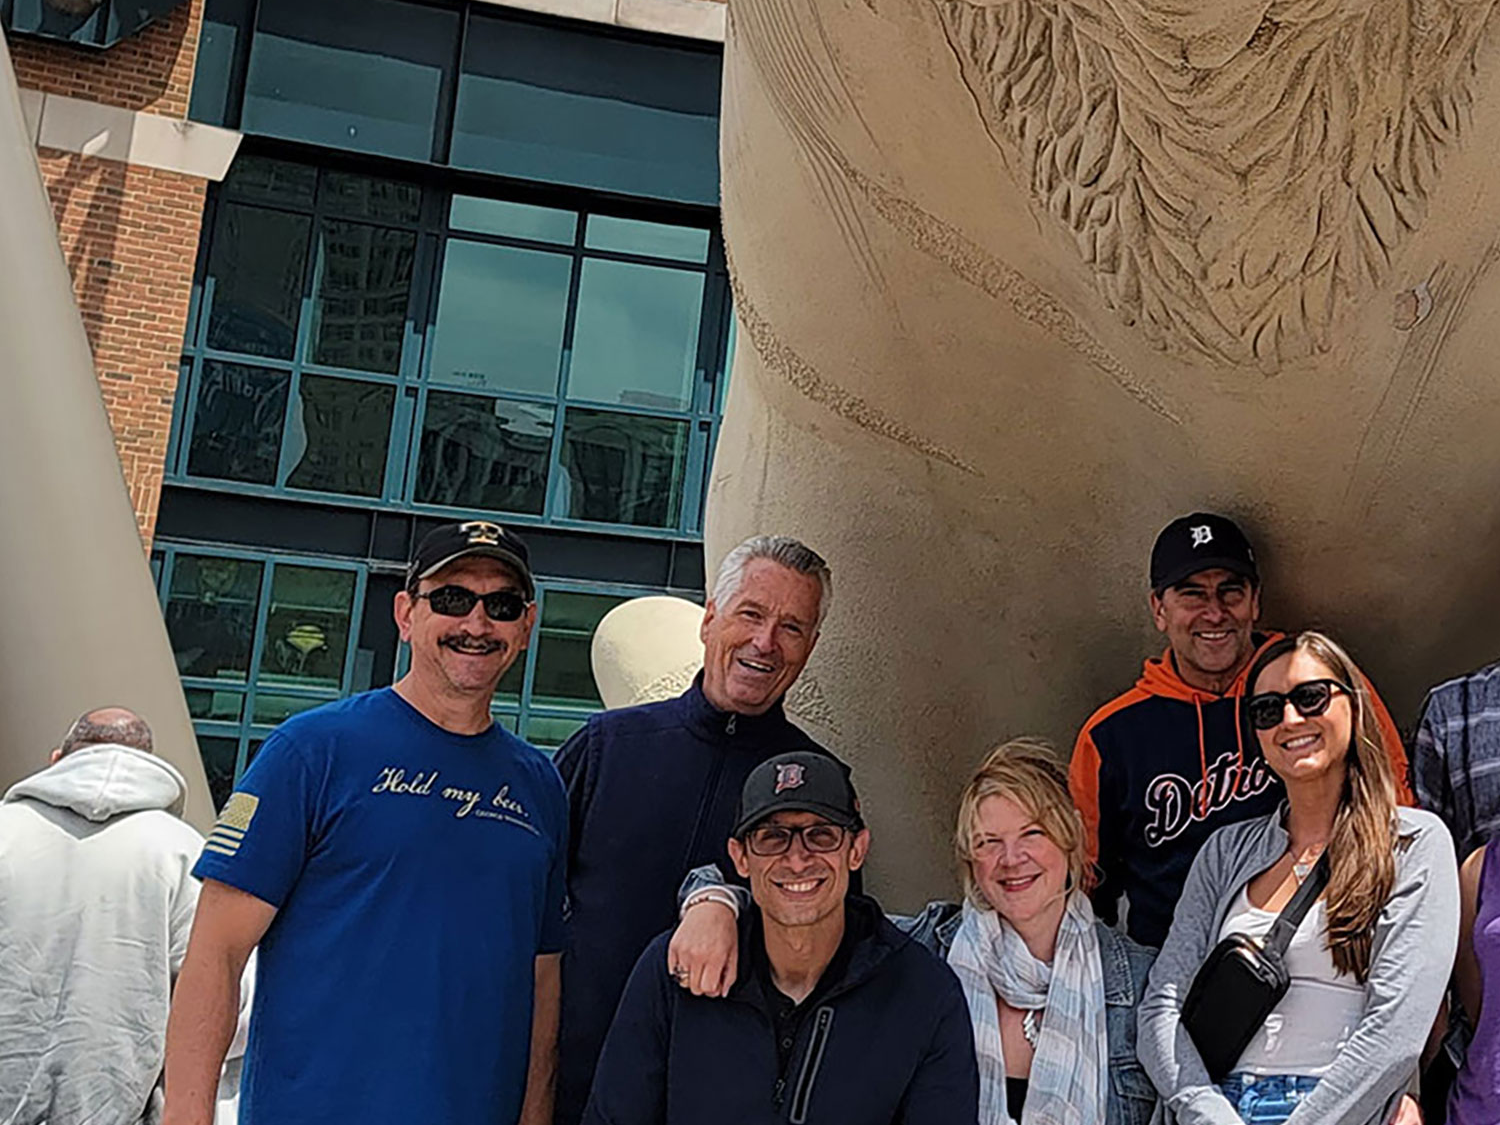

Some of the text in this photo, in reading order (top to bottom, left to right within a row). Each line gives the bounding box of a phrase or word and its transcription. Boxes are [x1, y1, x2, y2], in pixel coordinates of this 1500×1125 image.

[372, 766, 439, 796] Hold
[442, 786, 481, 818] my
[1145, 751, 1278, 848] Detro
